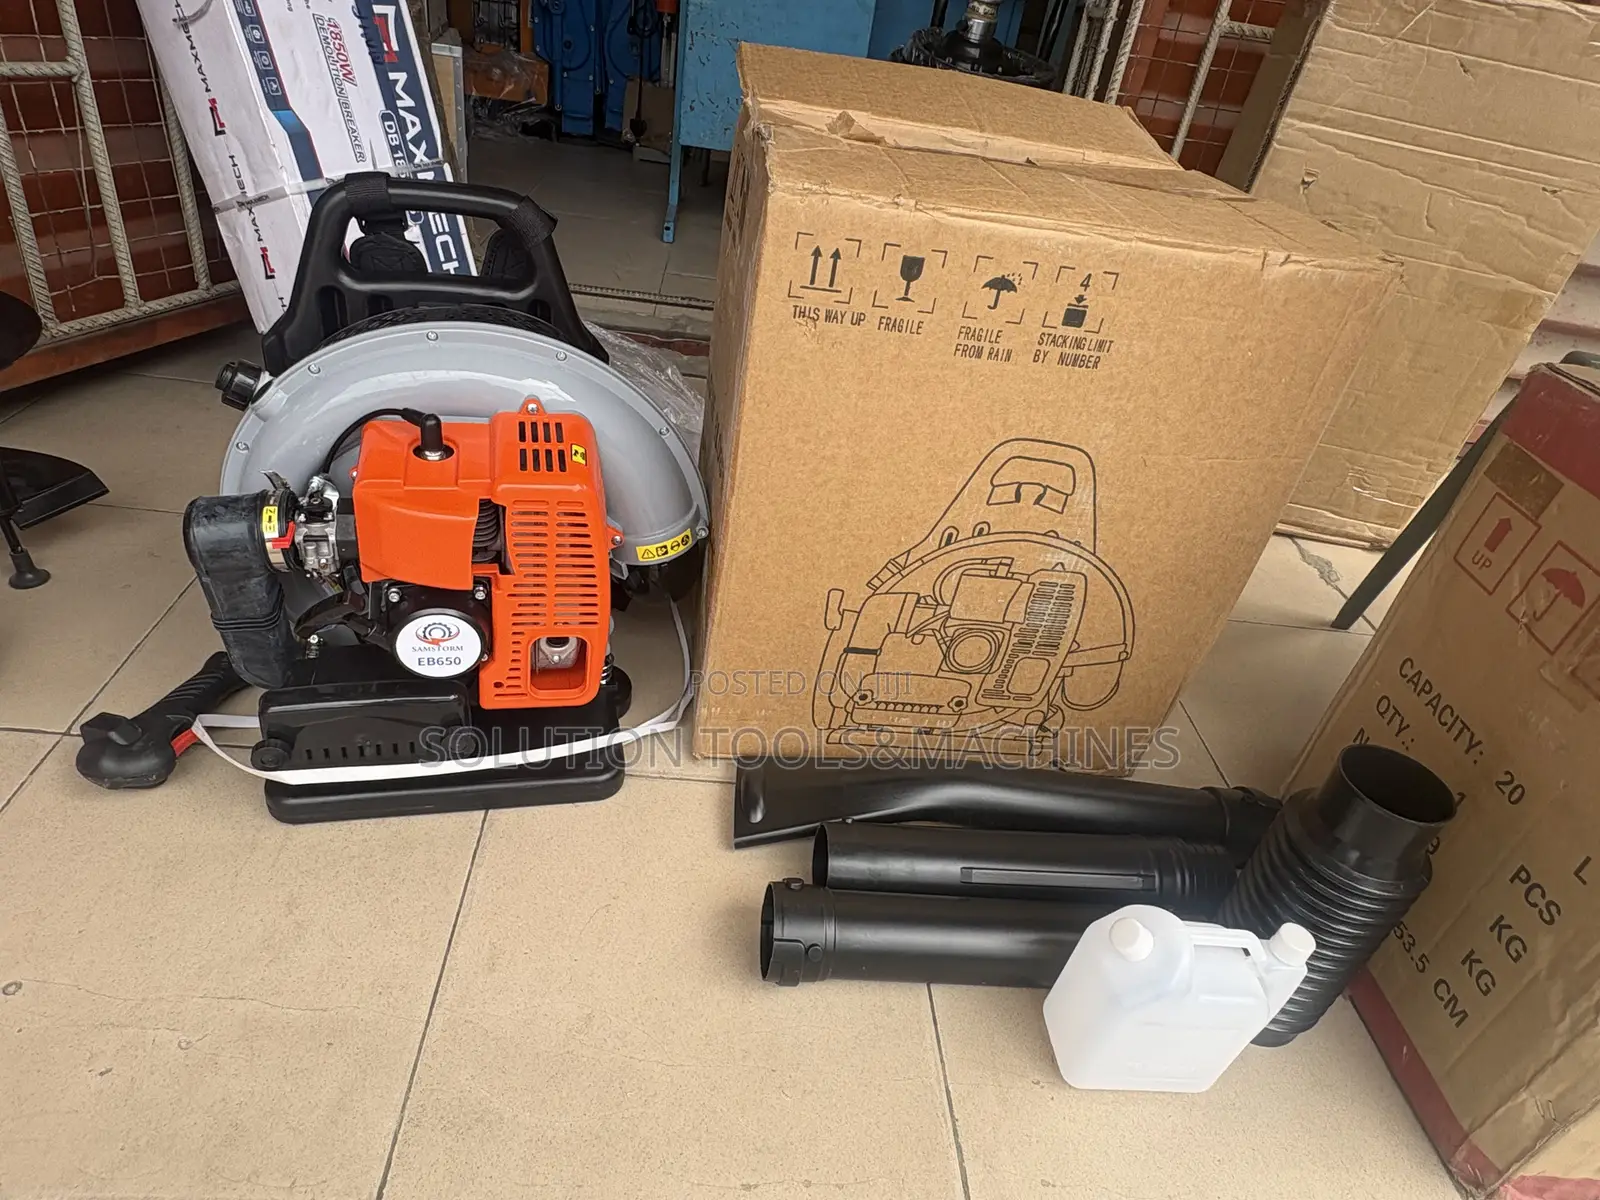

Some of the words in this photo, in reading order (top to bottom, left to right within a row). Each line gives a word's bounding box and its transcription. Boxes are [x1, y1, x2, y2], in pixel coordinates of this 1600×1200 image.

[326, 20, 356, 83] 1850W
[316, 17, 346, 95] DEMOLITION
[341, 100, 365, 162] BREAKER
[383, 121, 399, 143] DB
[1079, 273, 1092, 291] 4
[792, 304, 820, 321] THIS
[824, 308, 847, 324] WAY
[850, 312, 866, 326] UP
[877, 316, 924, 335] FRAGILE
[957, 325, 1003, 344] FRAGILE
[1037, 332, 1087, 351] STACKING
[953, 343, 984, 359] FROM
[986, 346, 1013, 362] RAIN
[1032, 349, 1050, 364] BY
[1057, 352, 1101, 370] NUMBER
[1471, 551, 1492, 570] UP
[411, 645, 463, 653] SAMSTORM
[417, 656, 462, 667] EB650
[1399, 657, 1483, 764] CAPACITY:
[1494, 770, 1526, 805] 20
[1573, 855, 1592, 886] L
[1509, 864, 1562, 926] PCS
[1489, 914, 1528, 963] KG
[1461, 948, 1497, 996] KG
[1433, 978, 1469, 1029] CM
